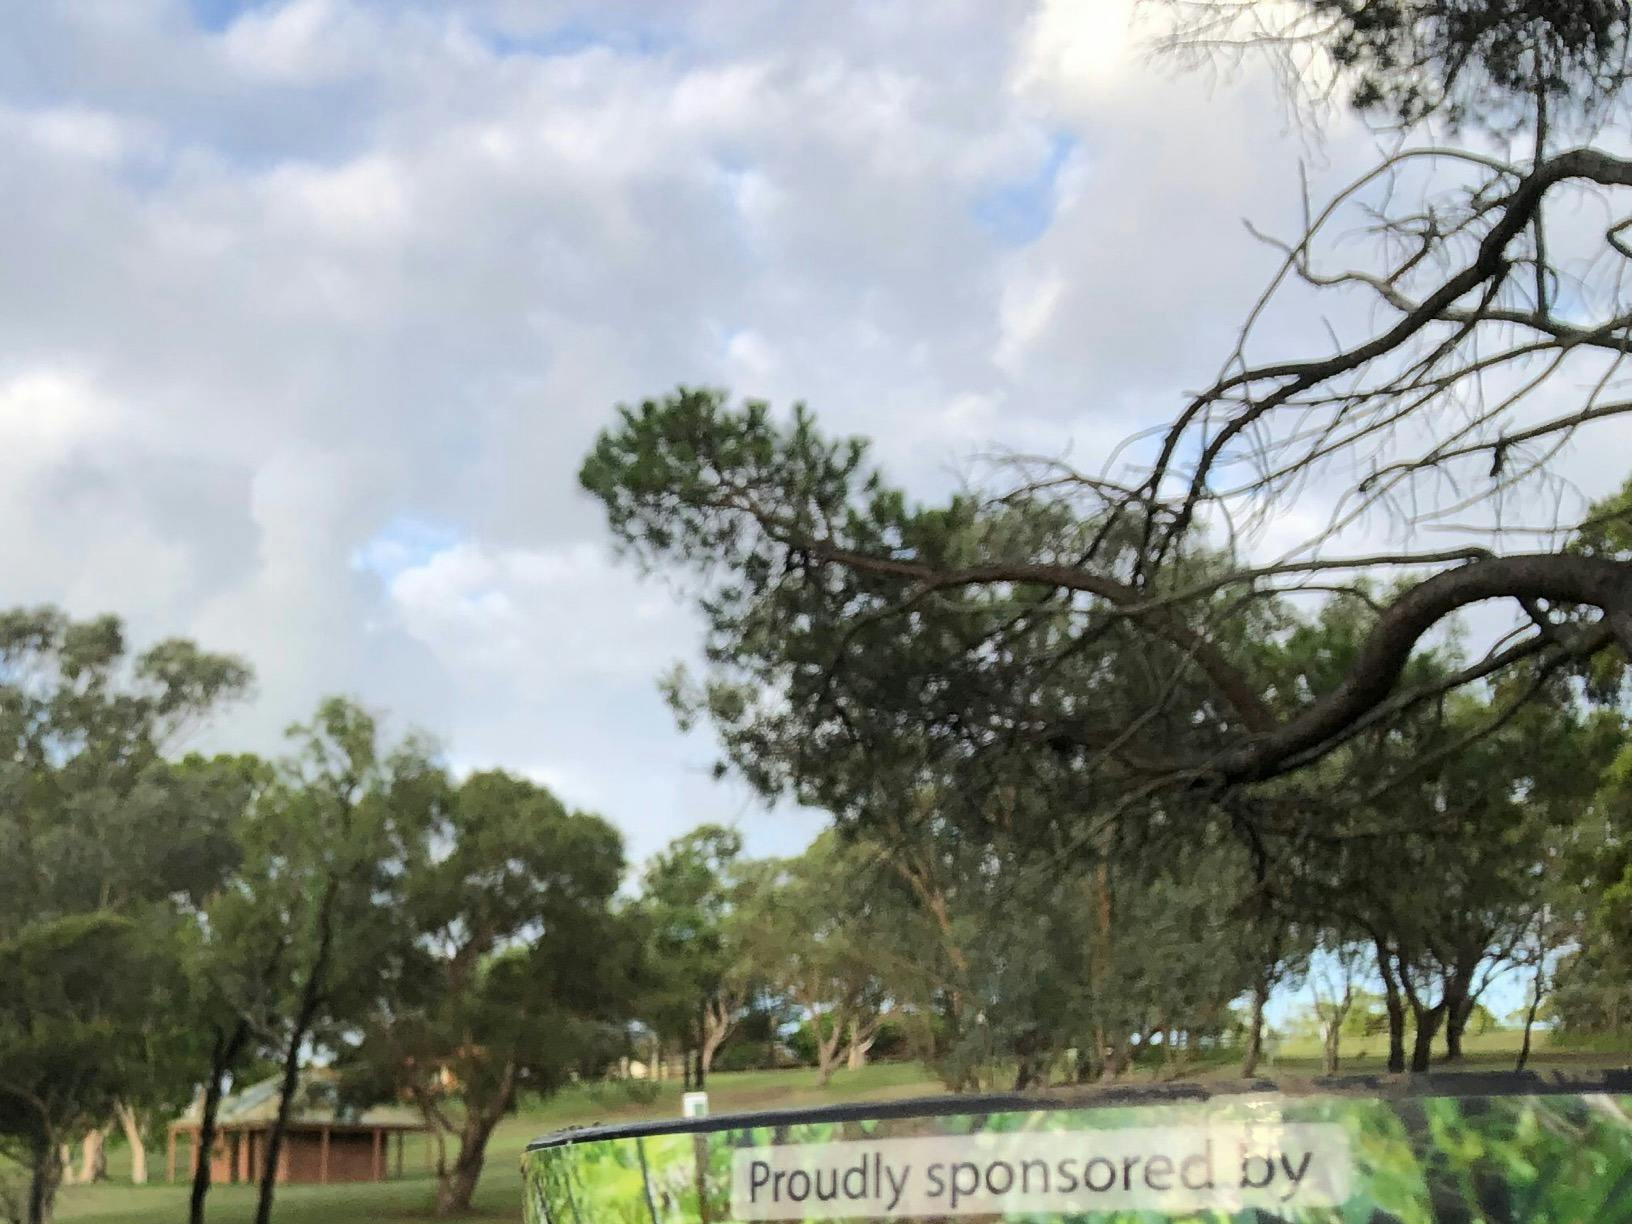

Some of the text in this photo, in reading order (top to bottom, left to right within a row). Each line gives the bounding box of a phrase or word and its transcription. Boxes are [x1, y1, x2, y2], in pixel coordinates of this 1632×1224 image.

[750, 1137, 1313, 1210] Proudly sponsored by
